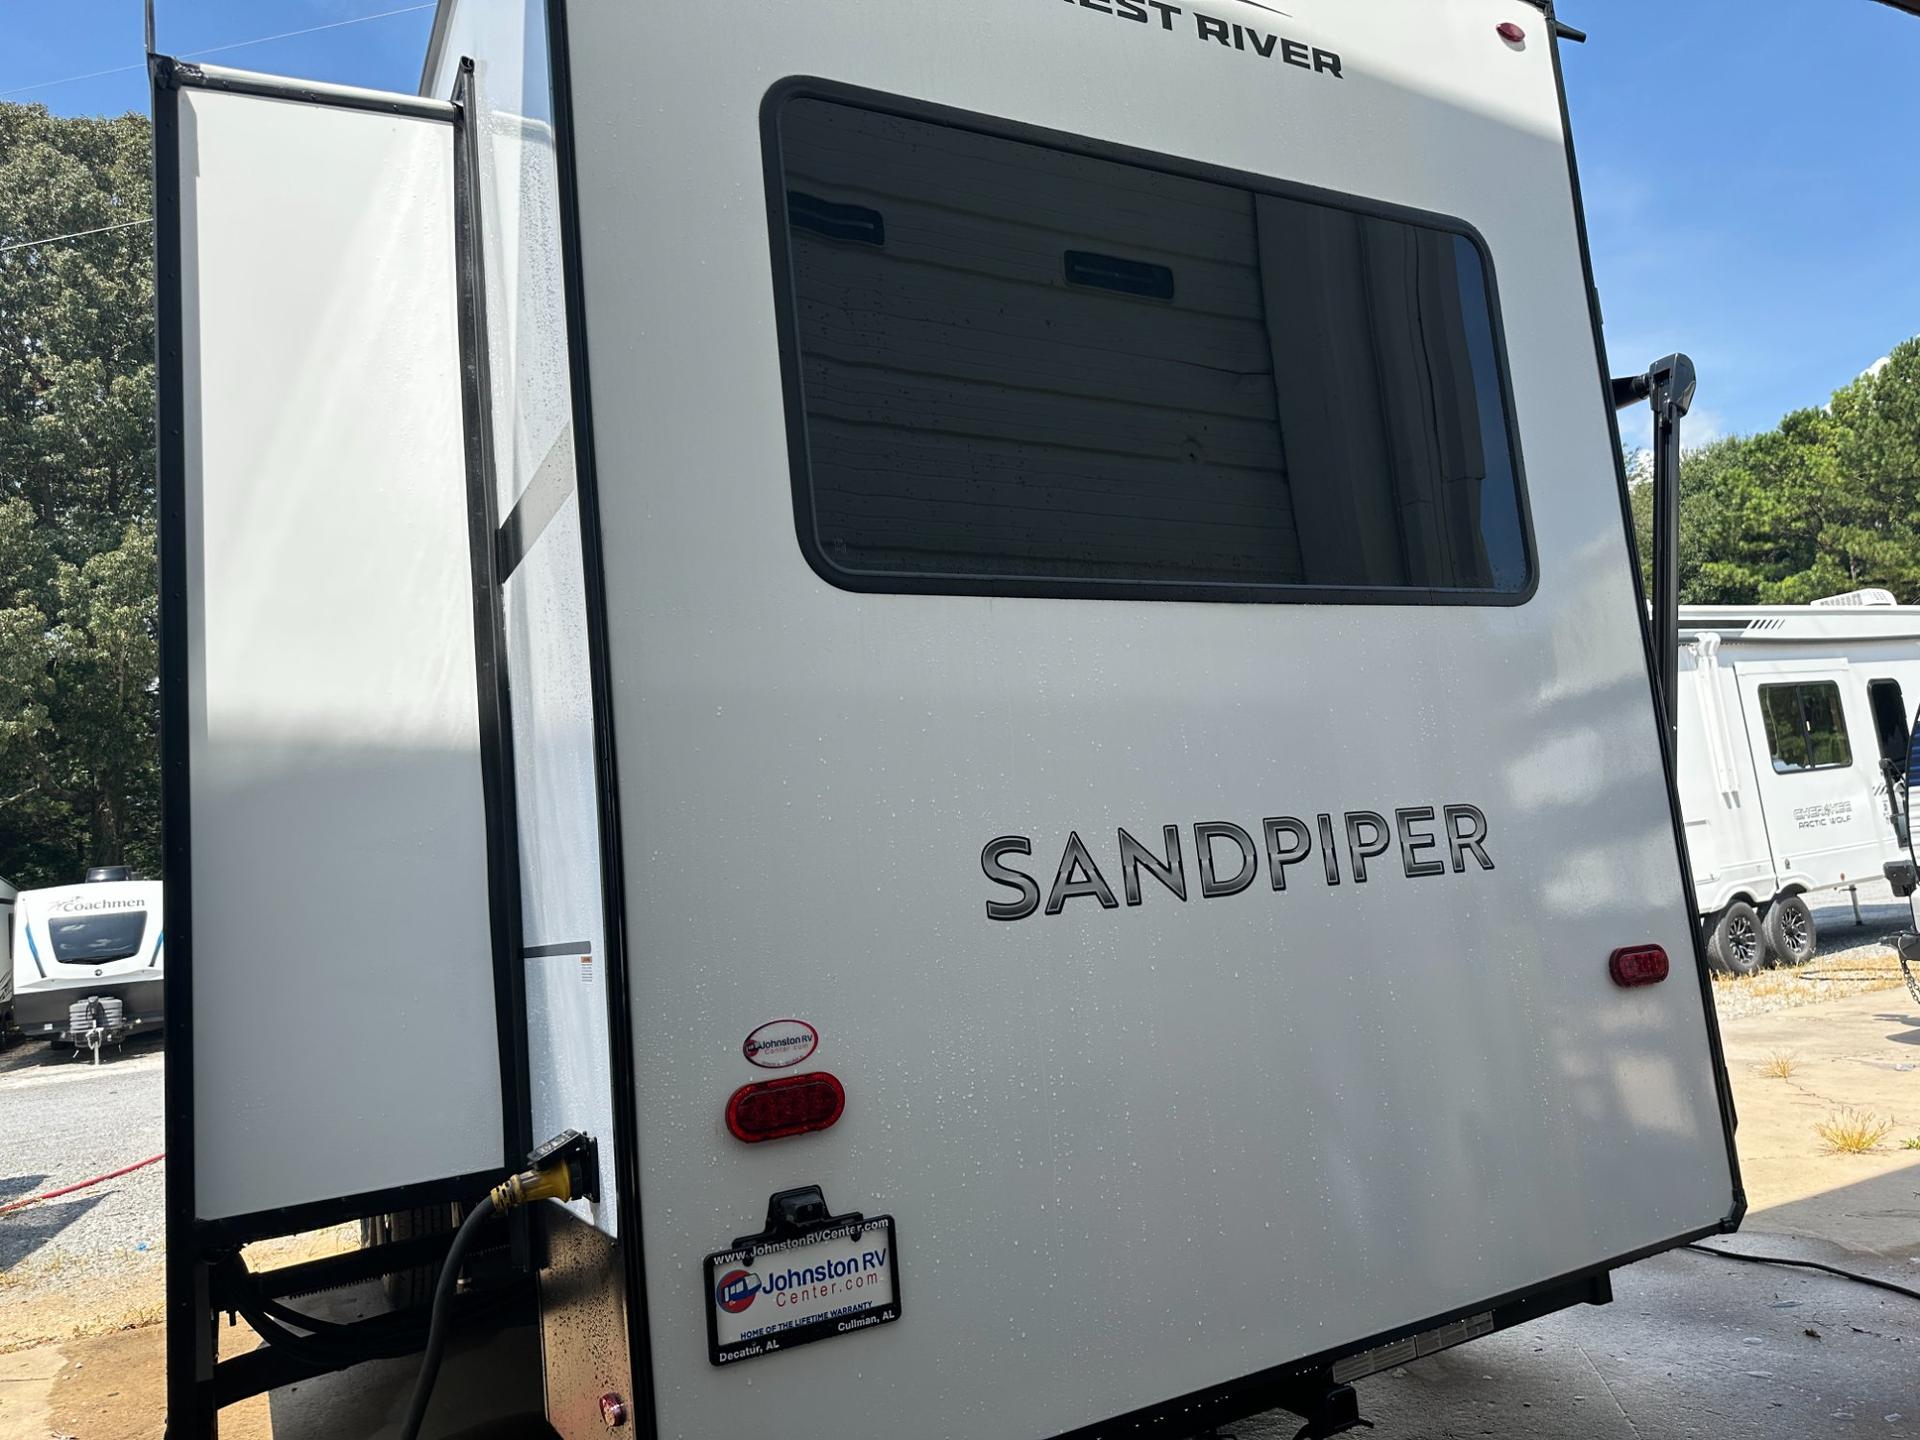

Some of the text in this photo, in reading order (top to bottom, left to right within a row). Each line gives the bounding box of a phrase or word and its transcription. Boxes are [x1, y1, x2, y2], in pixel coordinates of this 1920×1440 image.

[1063, 0, 1345, 80] ST RIVER
[1798, 814, 1852, 829] ARCTIC WOLF
[980, 803, 1495, 922] SANDPIPER
[63, 898, 145, 912] Coachmen
[759, 1034, 813, 1050] Johnston RV
[762, 1248, 887, 1294] Johnston RV
[776, 1272, 878, 1307] Center.com
[740, 1300, 874, 1340] HOME OF THE LIFETIME WARRANTY
[837, 1310, 896, 1332] Cullman, AL
[718, 1339, 780, 1363] Decatur, AL
